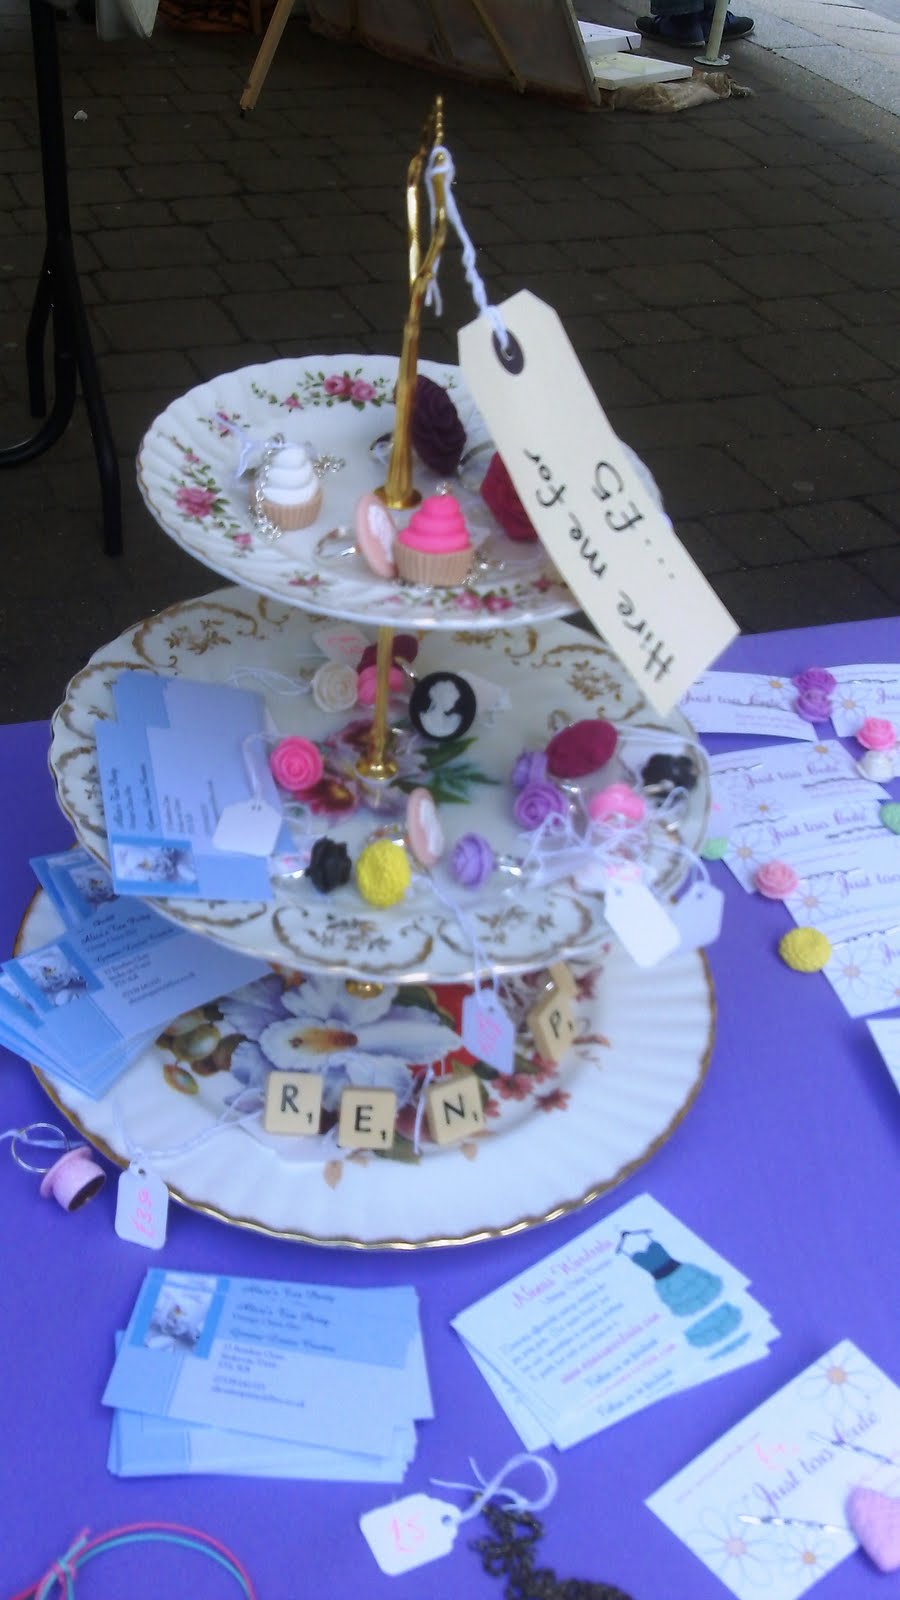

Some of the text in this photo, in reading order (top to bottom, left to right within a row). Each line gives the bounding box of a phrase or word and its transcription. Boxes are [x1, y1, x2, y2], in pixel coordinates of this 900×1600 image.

[523, 448, 674, 683] Hire me for
